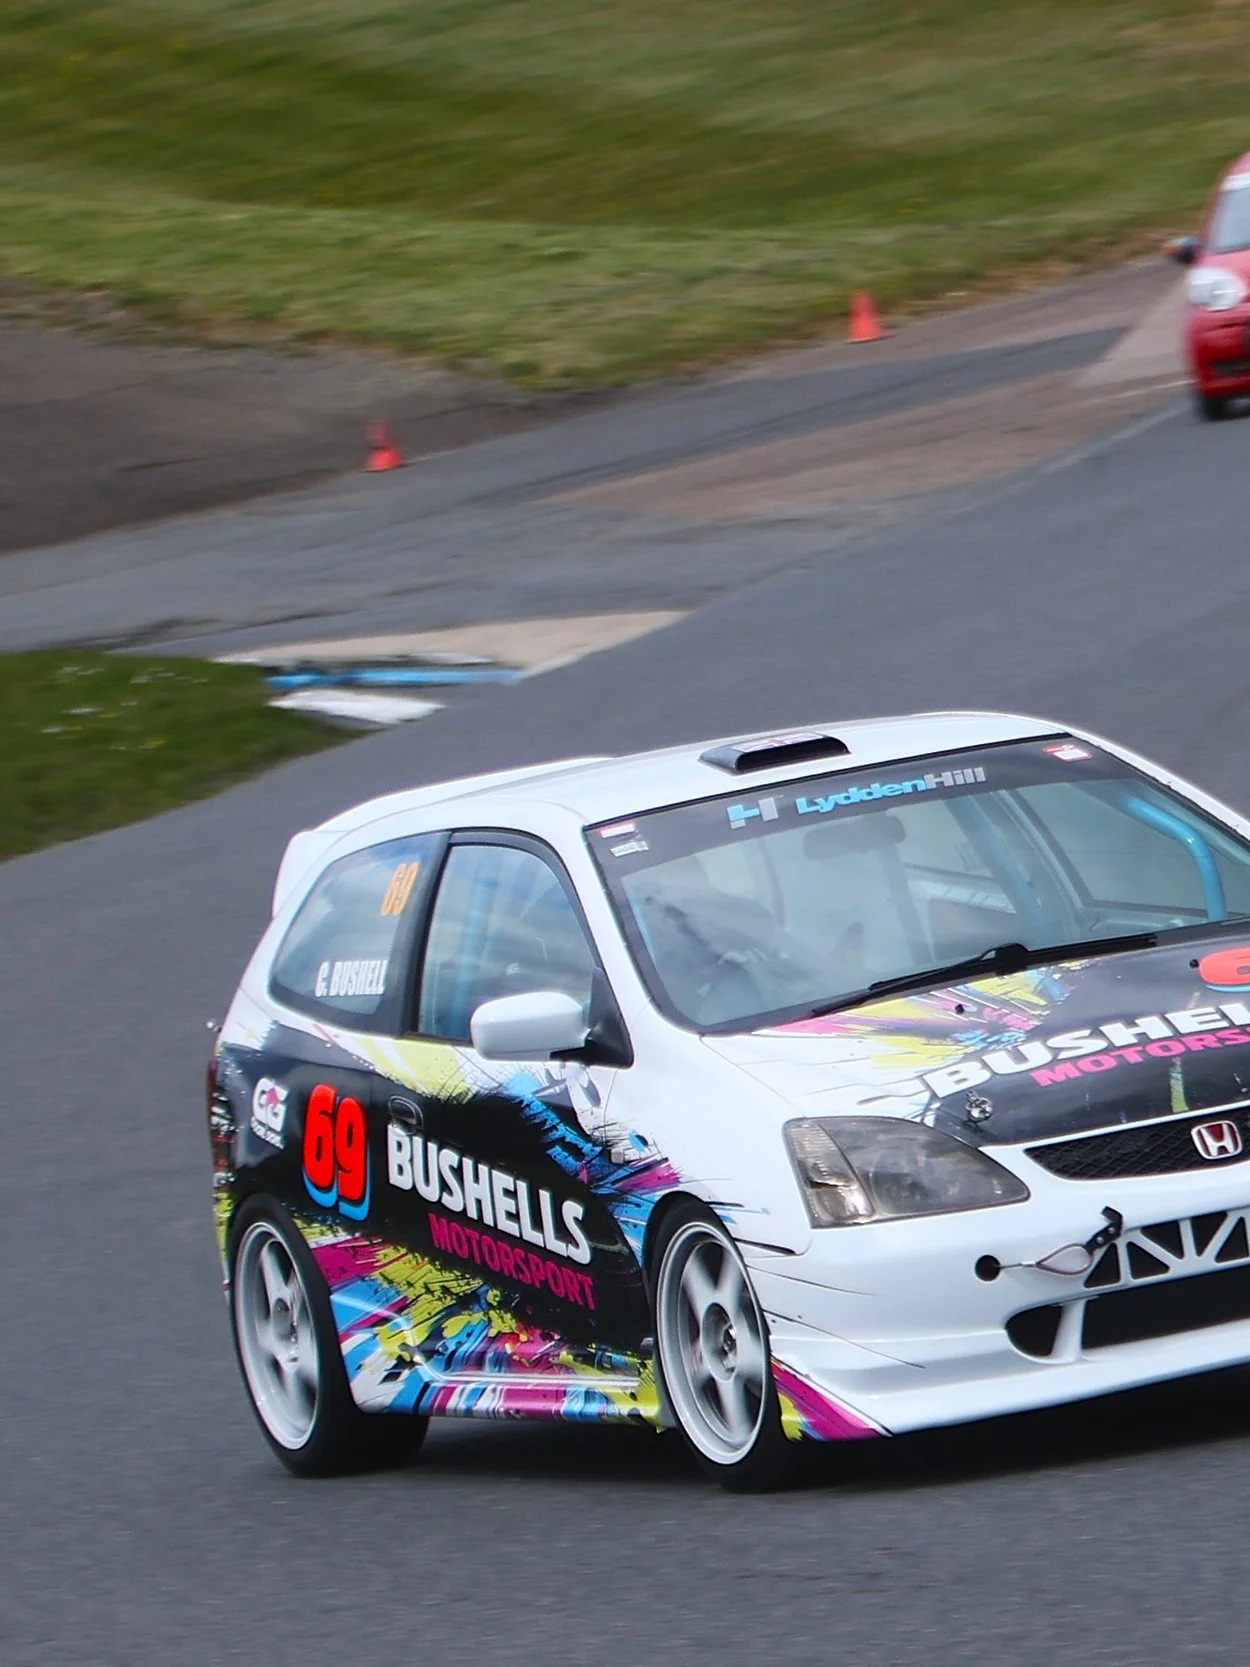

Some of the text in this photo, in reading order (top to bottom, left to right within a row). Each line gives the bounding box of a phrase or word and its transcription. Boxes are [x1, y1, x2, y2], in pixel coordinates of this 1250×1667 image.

[794, 766, 987, 815] LyddenHill
[329, 959, 388, 997] BUSHELL
[302, 1083, 371, 1221] 69
[387, 1123, 592, 1265] BUSHELLS
[428, 1212, 597, 1311] MOTORSPORT
